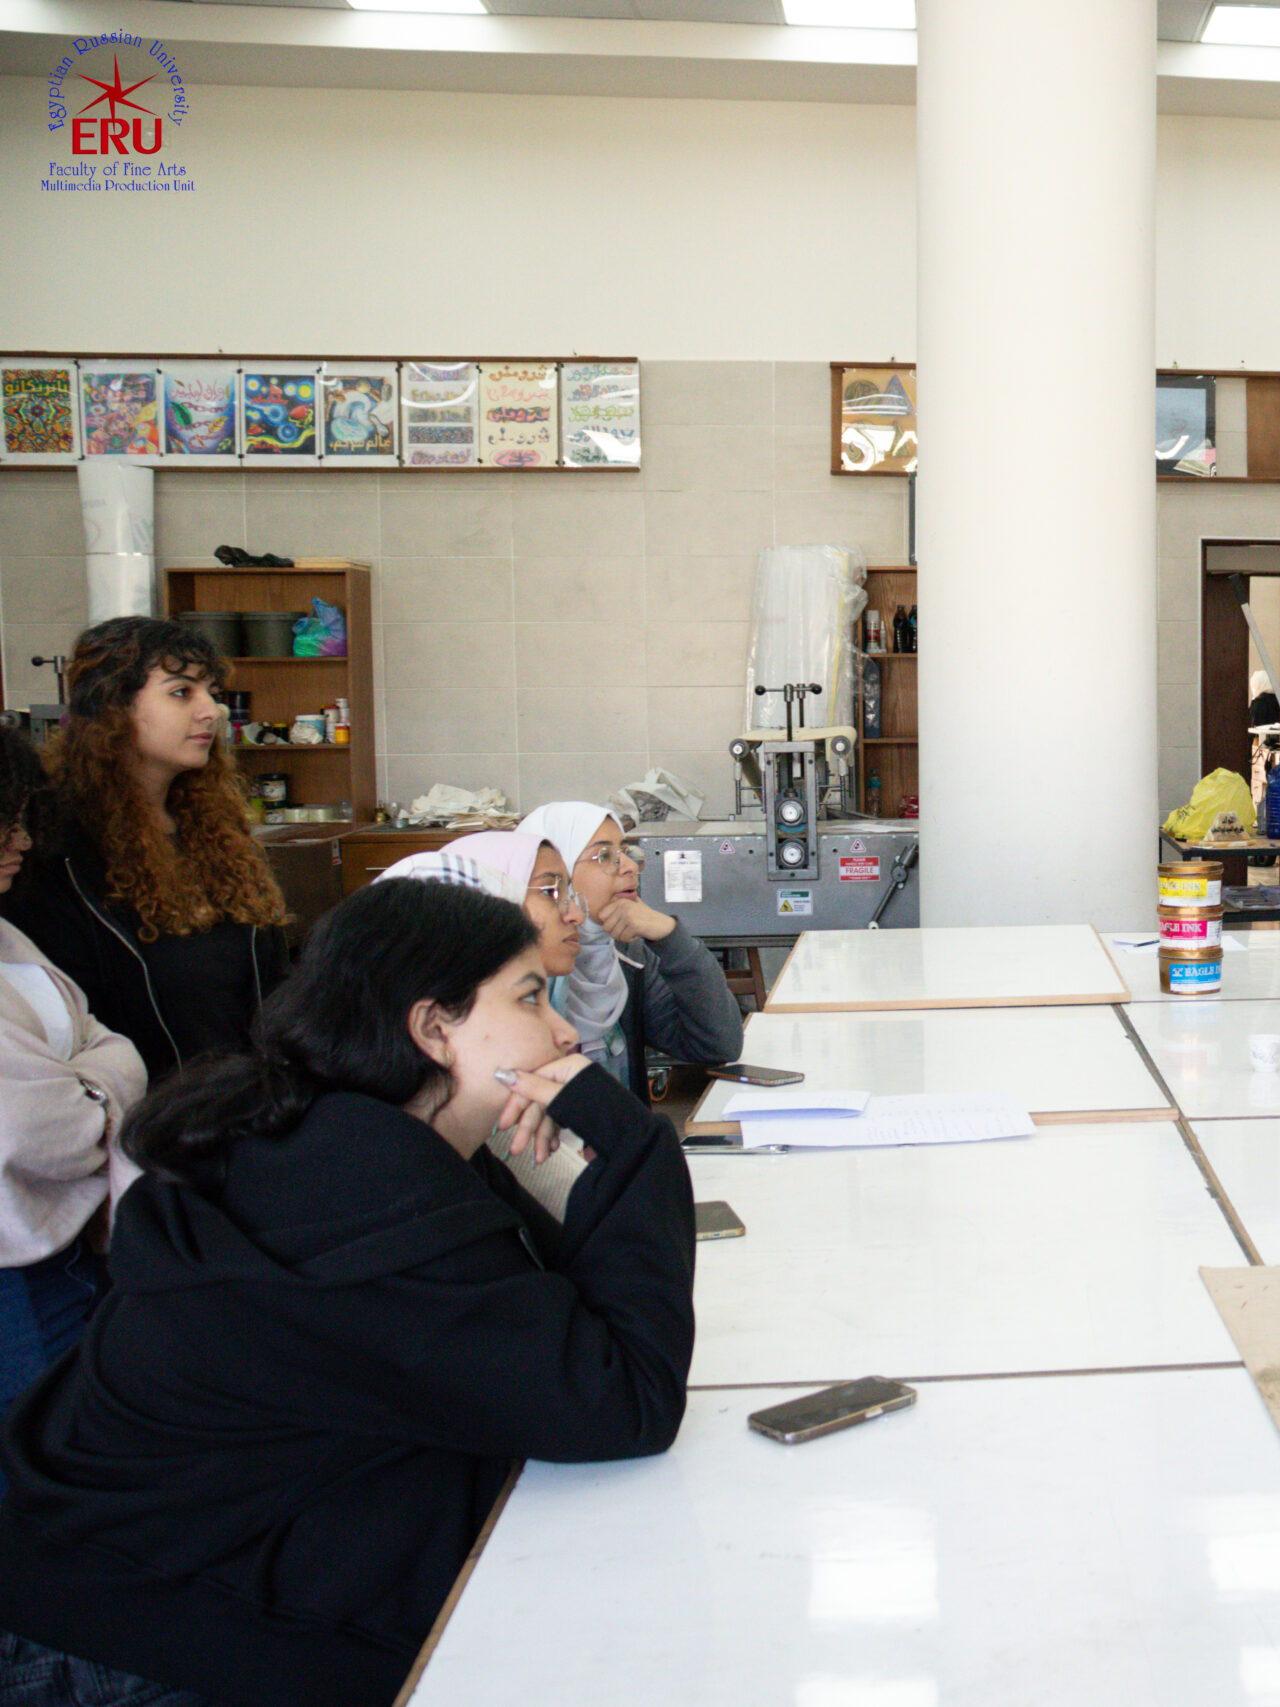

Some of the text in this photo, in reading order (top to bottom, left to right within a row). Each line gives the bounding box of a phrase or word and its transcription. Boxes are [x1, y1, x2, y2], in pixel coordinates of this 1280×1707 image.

[1160, 881, 1201, 891] AGLE INK
[1160, 922, 1202, 933] AGLE INK
[1184, 966, 1215, 977] EAGLE
